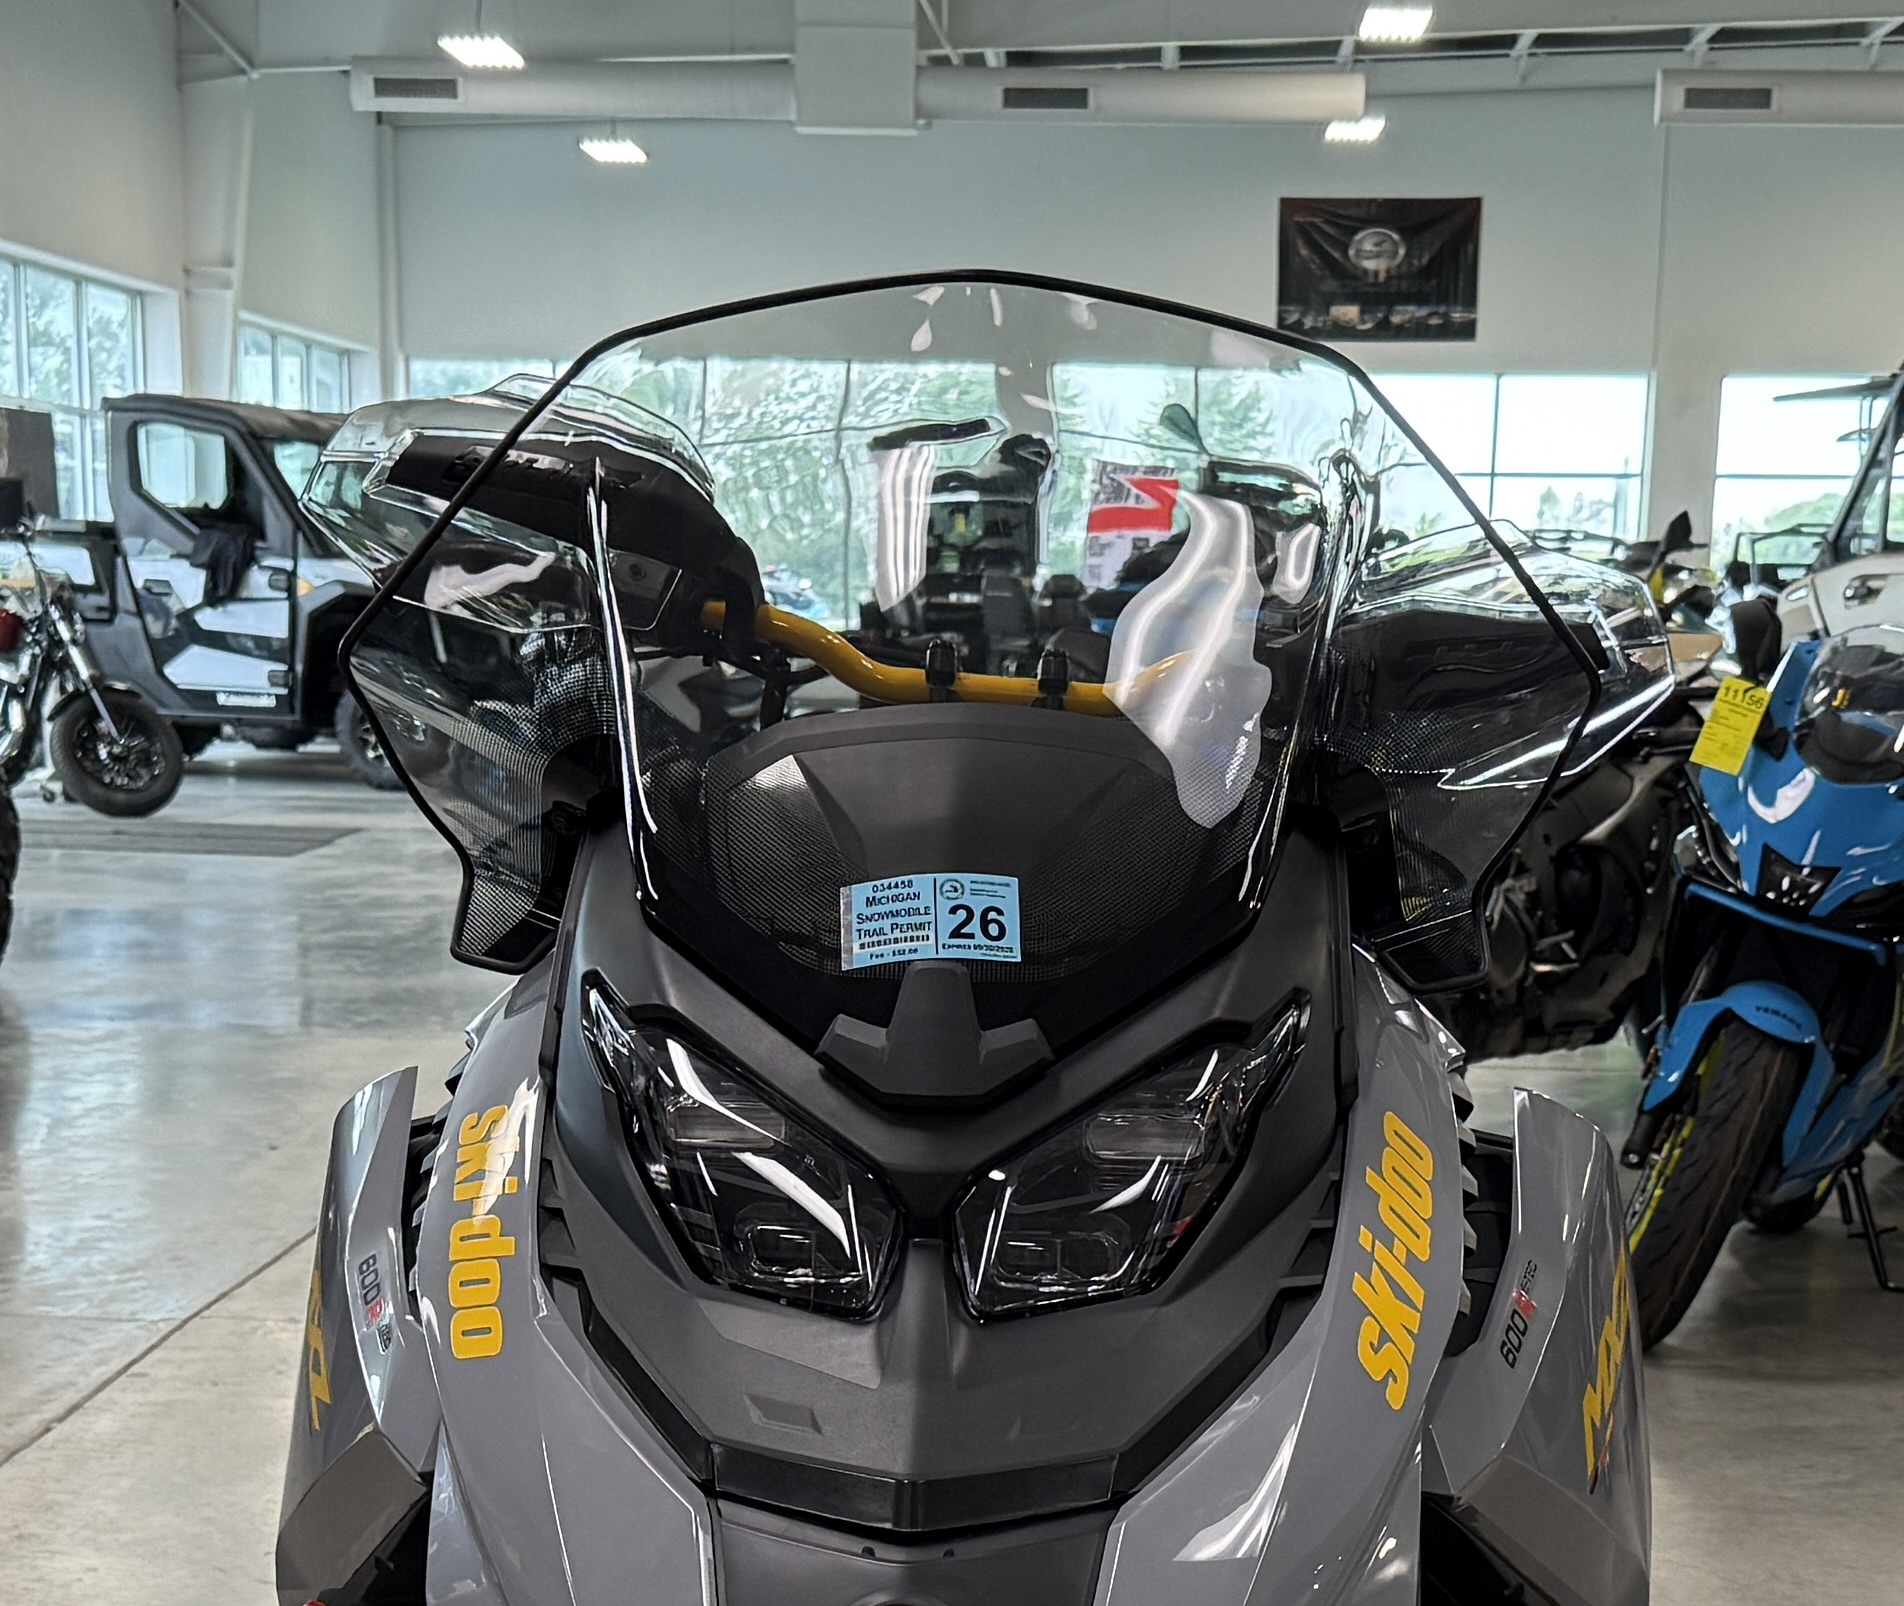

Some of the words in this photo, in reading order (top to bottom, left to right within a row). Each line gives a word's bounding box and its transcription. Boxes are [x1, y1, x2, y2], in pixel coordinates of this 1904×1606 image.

[865, 891, 921, 907] MICHIGAN
[856, 906, 932, 925] SNOWMOBILE
[947, 903, 1007, 942] 26
[856, 926, 888, 940] TRAIL
[890, 921, 933, 935] PERMIT
[1352, 1110, 1434, 1411] ski-doo
